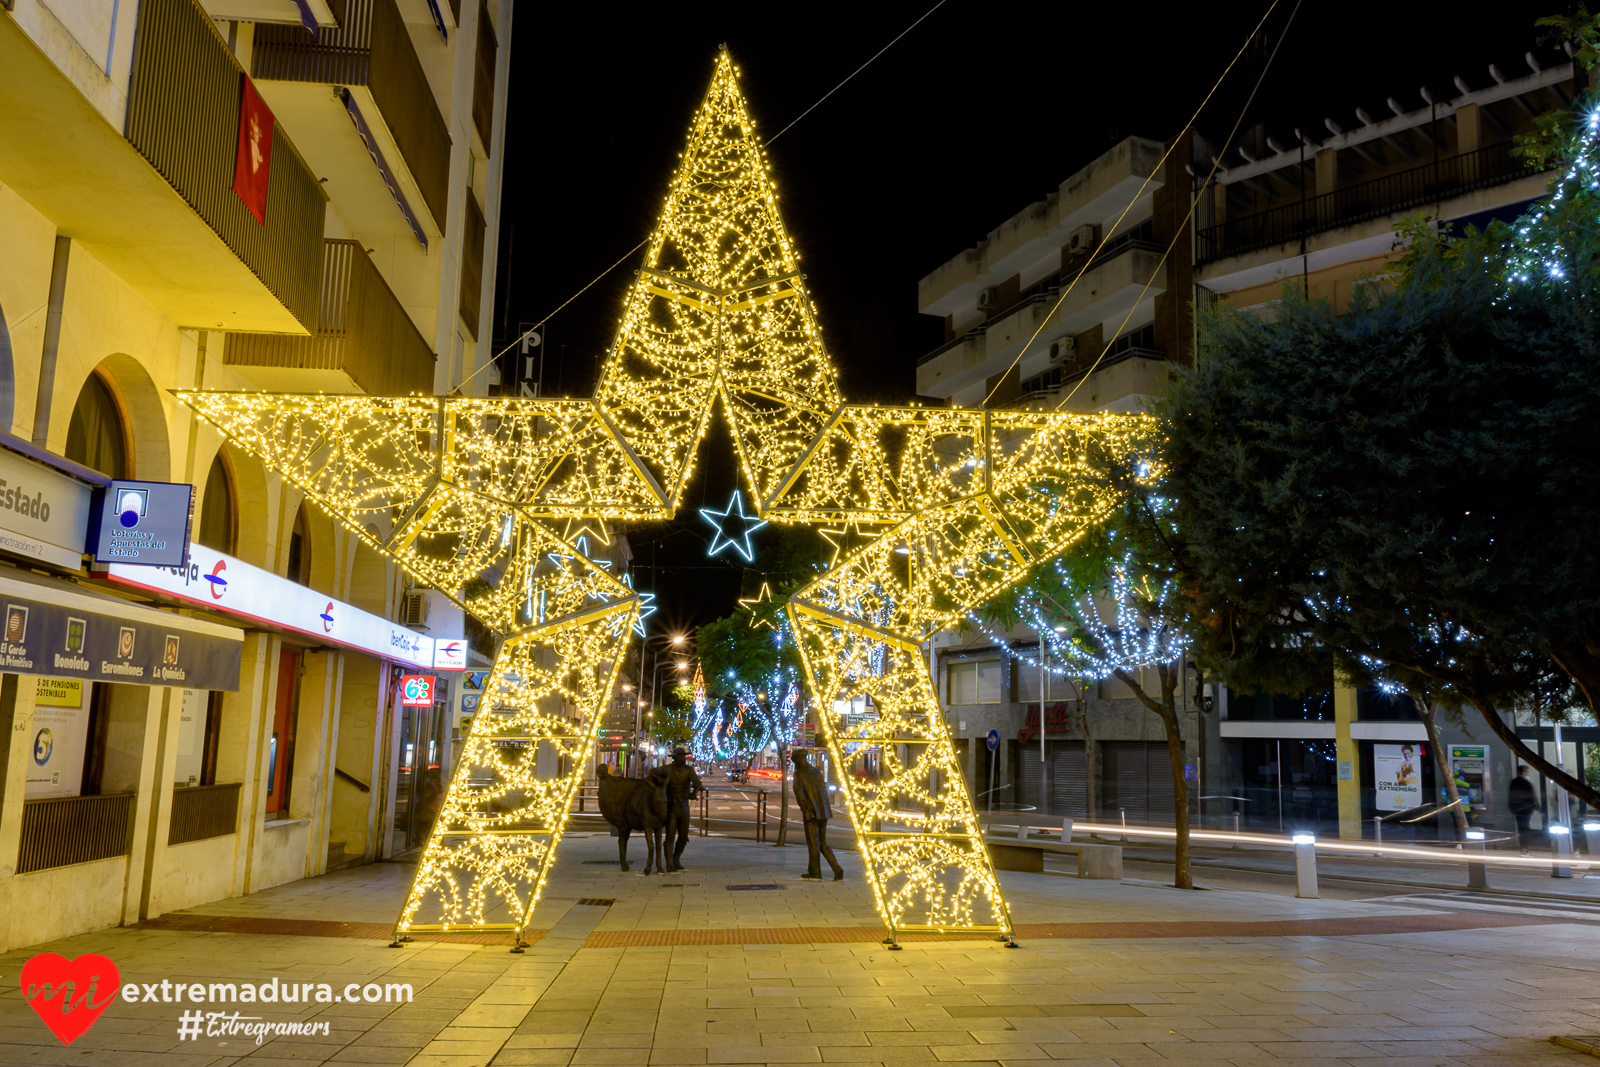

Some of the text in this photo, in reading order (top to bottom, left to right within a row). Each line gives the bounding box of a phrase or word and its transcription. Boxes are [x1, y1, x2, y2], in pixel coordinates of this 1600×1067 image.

[0, 478, 50, 523] Estado
[111, 529, 154, 541] Loterías y
[38, 545, 43, 556] 2
[110, 539, 166, 549] Apuestas del
[108, 548, 139, 557] Estado
[0, 642, 27, 656] El Gordo
[6, 654, 33, 669] Primitiva
[54, 653, 90, 671] Bonoloto
[101, 660, 144, 677] Euromillones
[152, 665, 186, 681] La Quiniela
[42, 679, 50, 687] DE
[51, 680, 80, 690] PENSIONES
